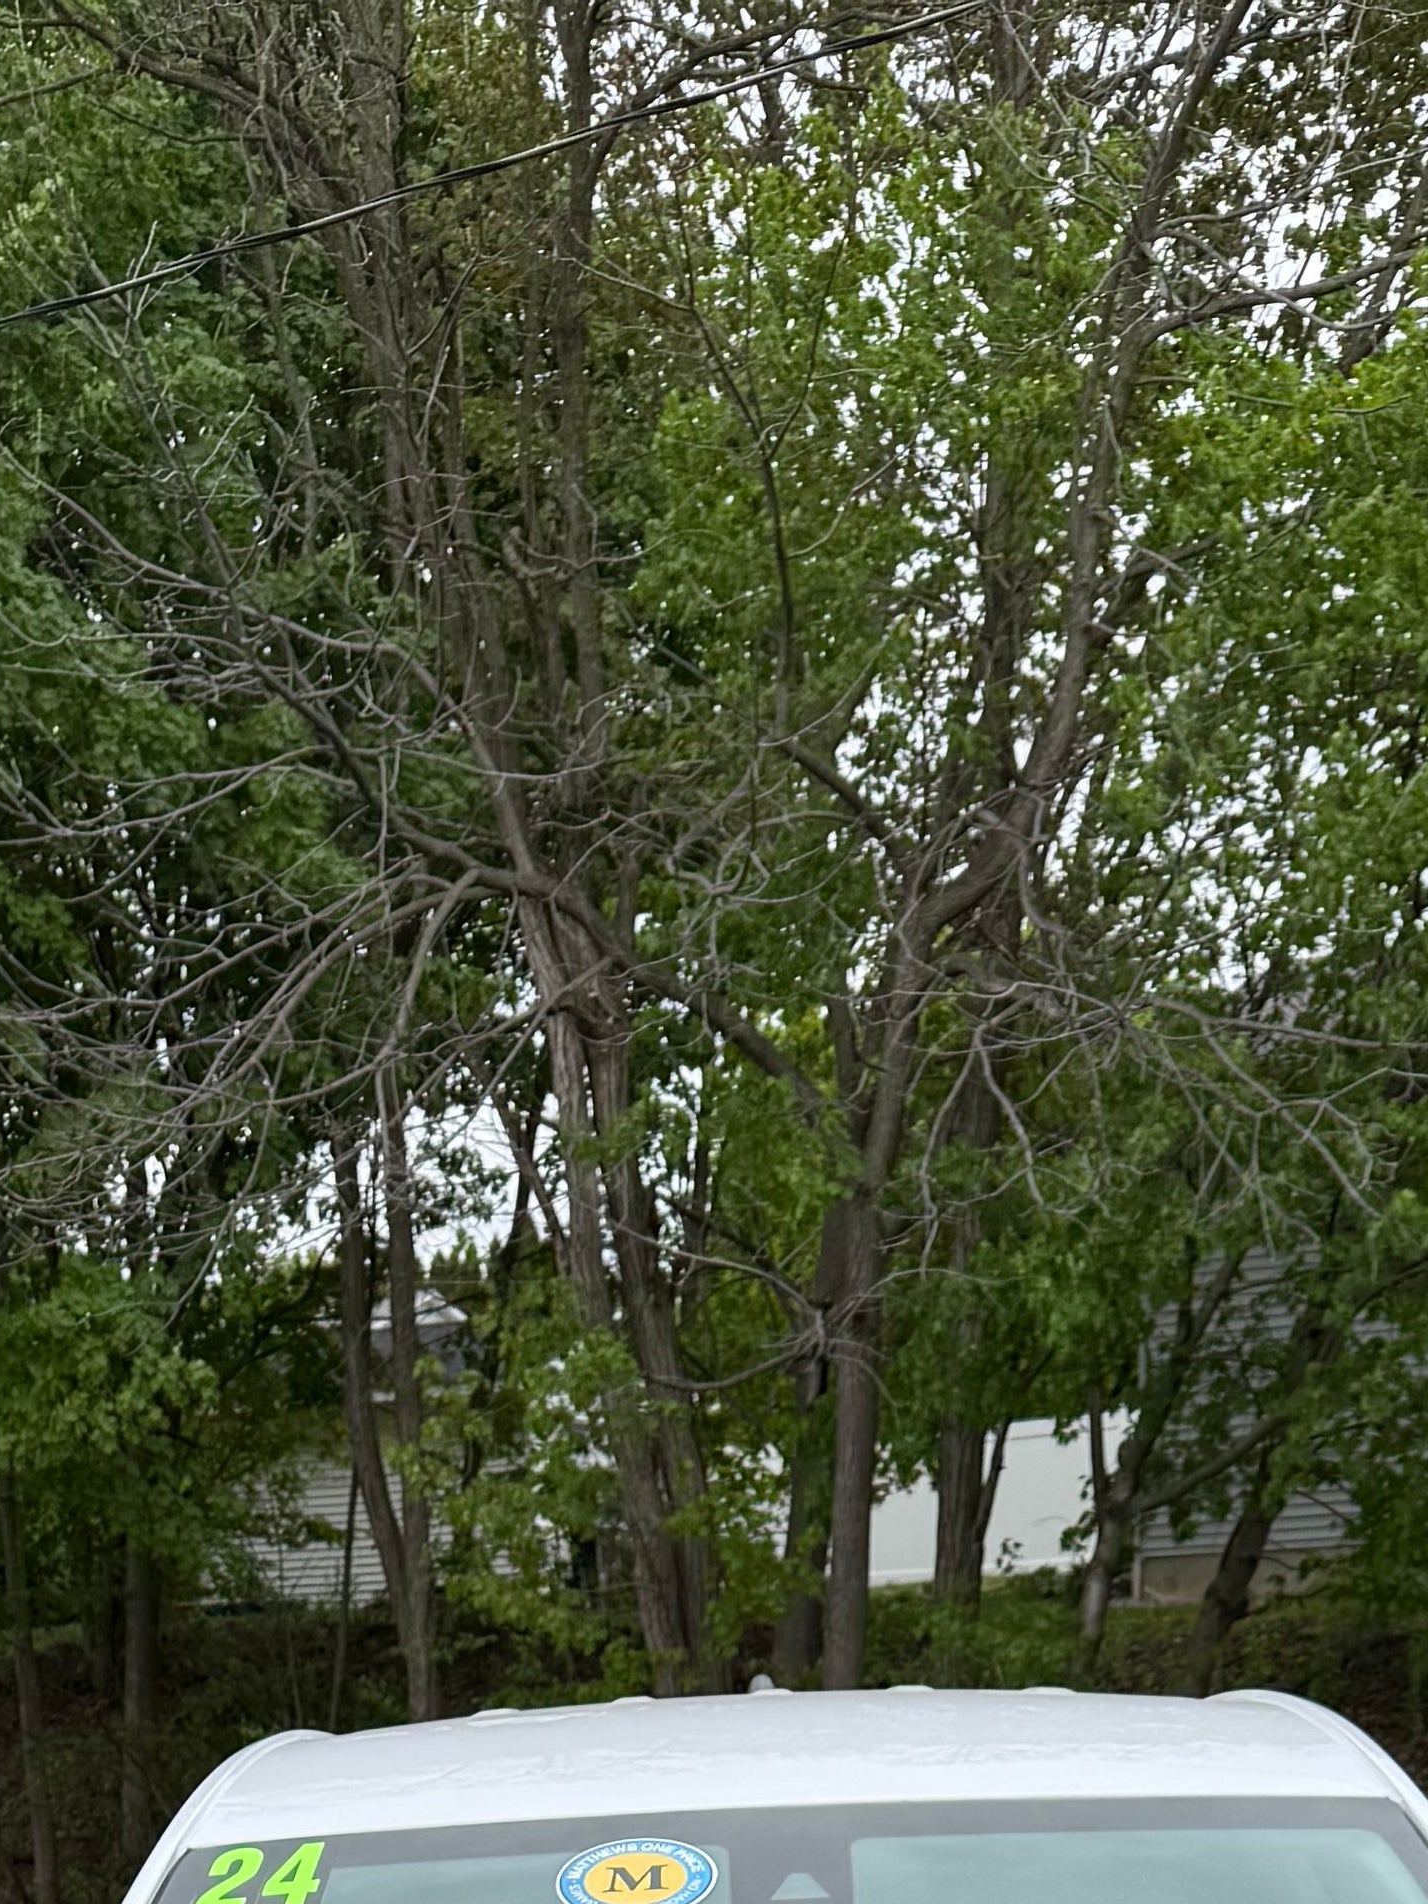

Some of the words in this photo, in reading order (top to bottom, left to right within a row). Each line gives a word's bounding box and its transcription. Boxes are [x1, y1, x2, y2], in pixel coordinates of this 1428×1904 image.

[566, 1843, 638, 1880] MATTHEWS
[640, 1842, 674, 1854] ONE
[602, 1864, 669, 1893] M
